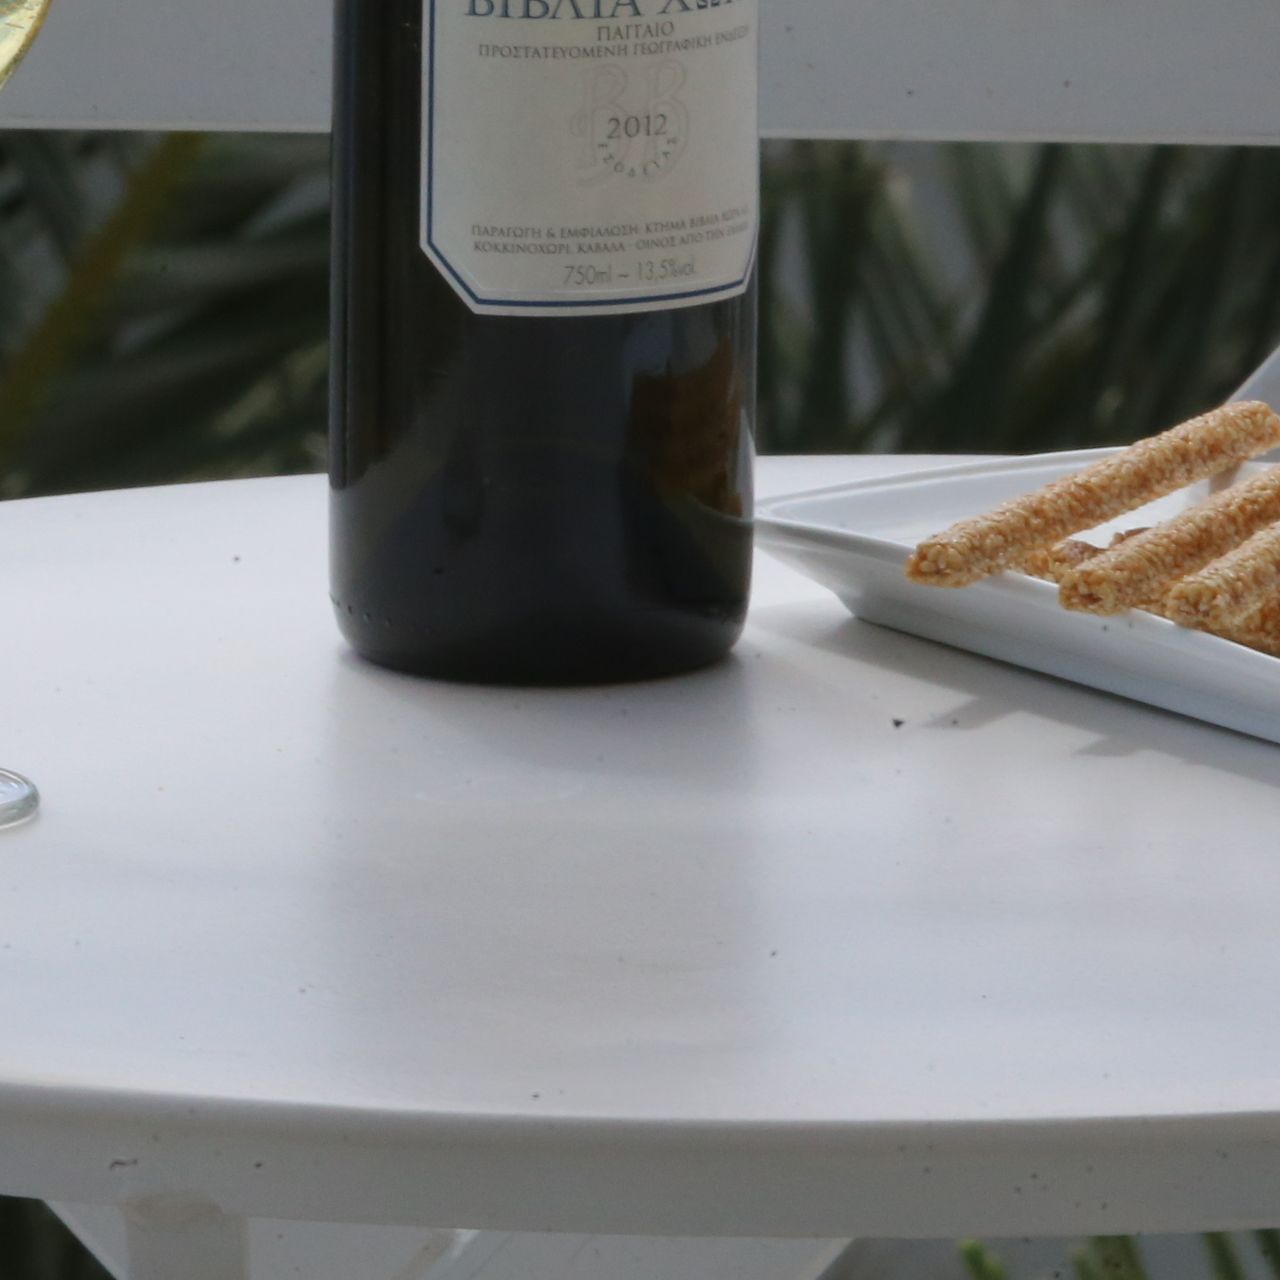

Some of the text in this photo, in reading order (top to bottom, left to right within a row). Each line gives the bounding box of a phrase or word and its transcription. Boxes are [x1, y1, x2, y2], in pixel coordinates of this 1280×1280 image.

[596, 21, 674, 42] ΠΑΓΓΑΙΟ
[478, 43, 627, 60] ΠΡΟΣΤΑΤΕΥΟΜΕΝΗ
[607, 113, 668, 140] 2012
[563, 264, 612, 286] 750ml
